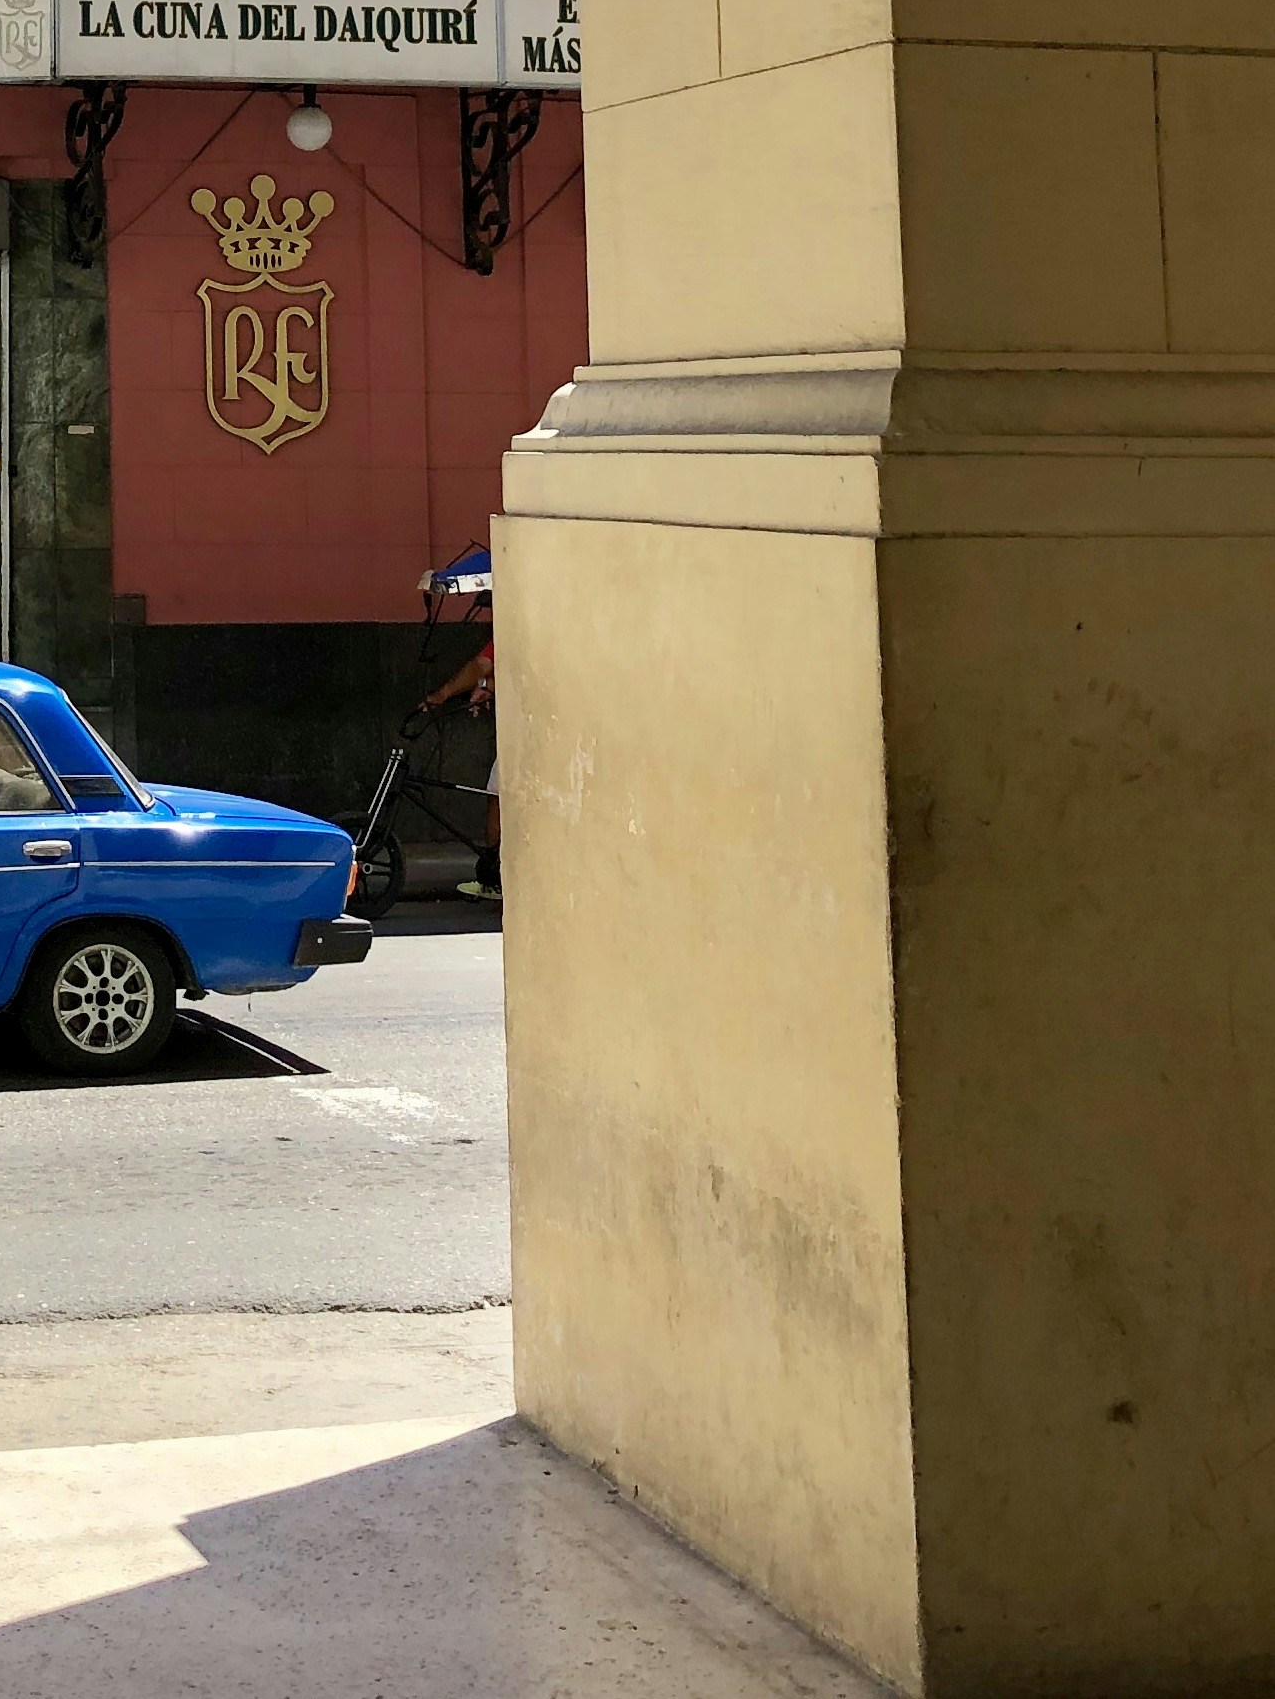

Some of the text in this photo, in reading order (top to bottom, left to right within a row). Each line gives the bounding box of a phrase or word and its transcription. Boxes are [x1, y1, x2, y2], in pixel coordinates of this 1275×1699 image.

[79, 0, 125, 38] LA
[133, 1, 229, 40] CUNA
[238, 3, 306, 41] DEL
[522, 25, 582, 73] MÁS
